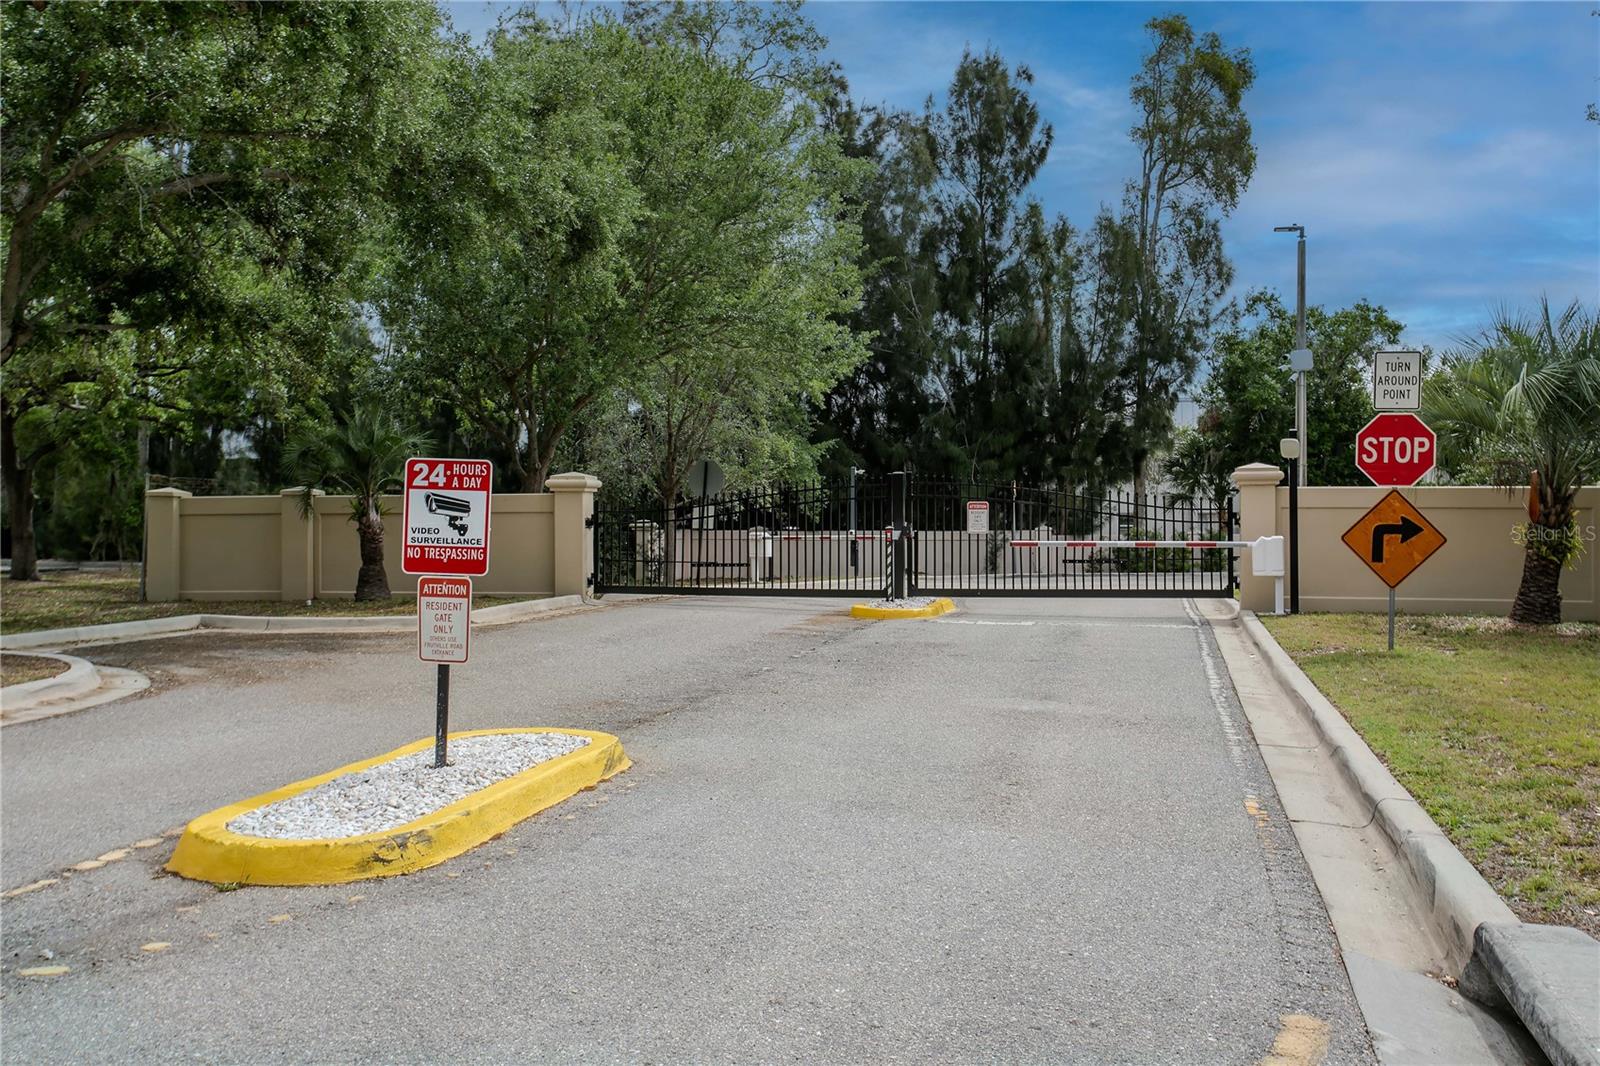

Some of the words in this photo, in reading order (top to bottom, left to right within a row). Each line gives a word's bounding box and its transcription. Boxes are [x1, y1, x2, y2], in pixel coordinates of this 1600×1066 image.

[1386, 362, 1411, 372] TURN
[1377, 376, 1418, 386] AROUND
[1383, 389, 1411, 400] POINT
[1361, 436, 1430, 464] STOP
[412, 463, 447, 487] 24
[453, 464, 487, 475] HOURS
[452, 477, 459, 488] A
[463, 477, 482, 489] DAY
[411, 527, 440, 535] VIDEO
[410, 536, 482, 546] SURVEILLANCE
[407, 547, 421, 559] NO
[424, 548, 484, 560] TRESPASSING
[423, 584, 467, 595] ATTENTION
[425, 601, 463, 611] RESIDENT
[434, 613, 453, 622] GATE
[433, 624, 454, 634] ONLY
